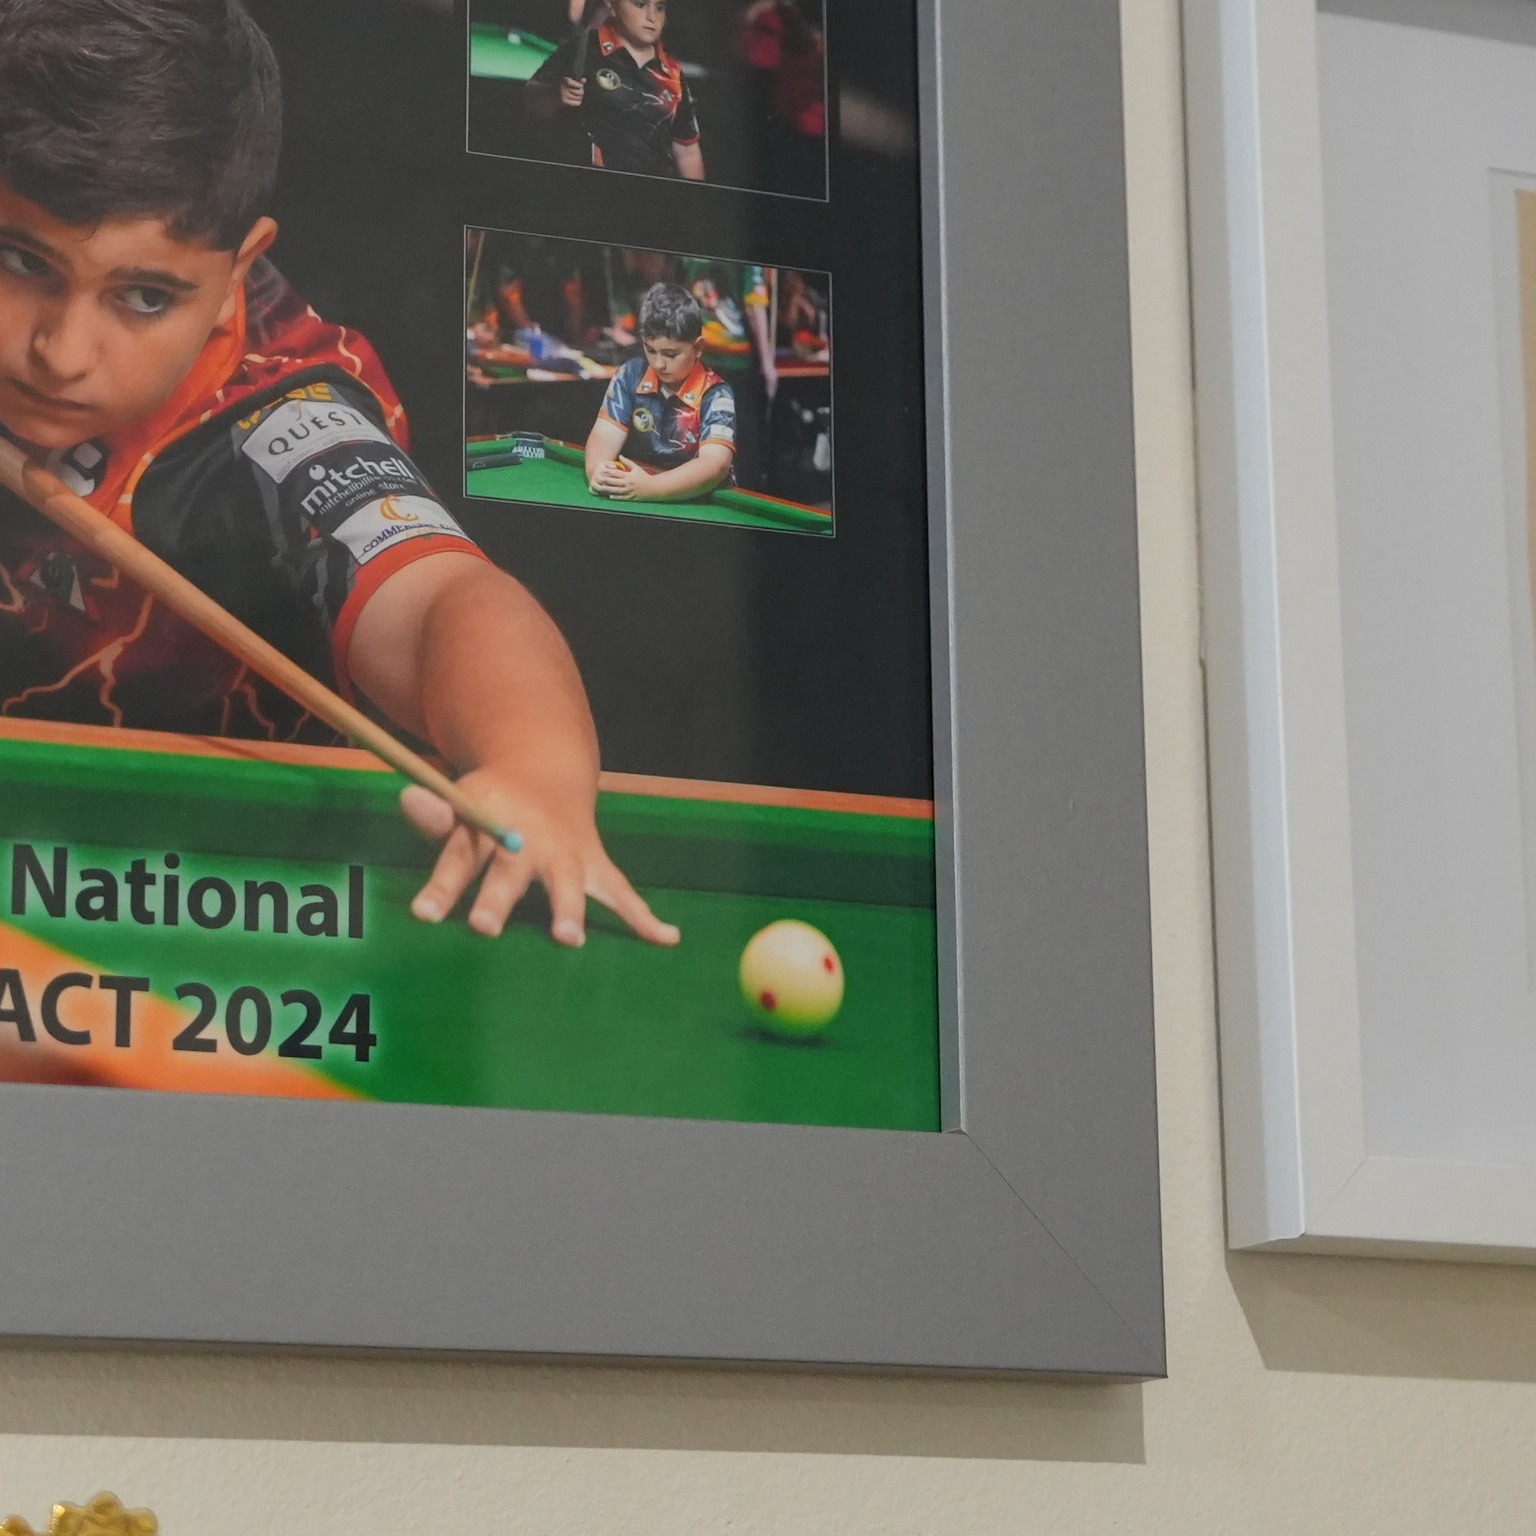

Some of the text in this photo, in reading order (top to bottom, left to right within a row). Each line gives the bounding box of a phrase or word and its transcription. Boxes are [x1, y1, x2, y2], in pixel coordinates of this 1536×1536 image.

[301, 456, 416, 515] mitchell
[9, 842, 366, 939] National
[173, 980, 378, 1064] 2024
